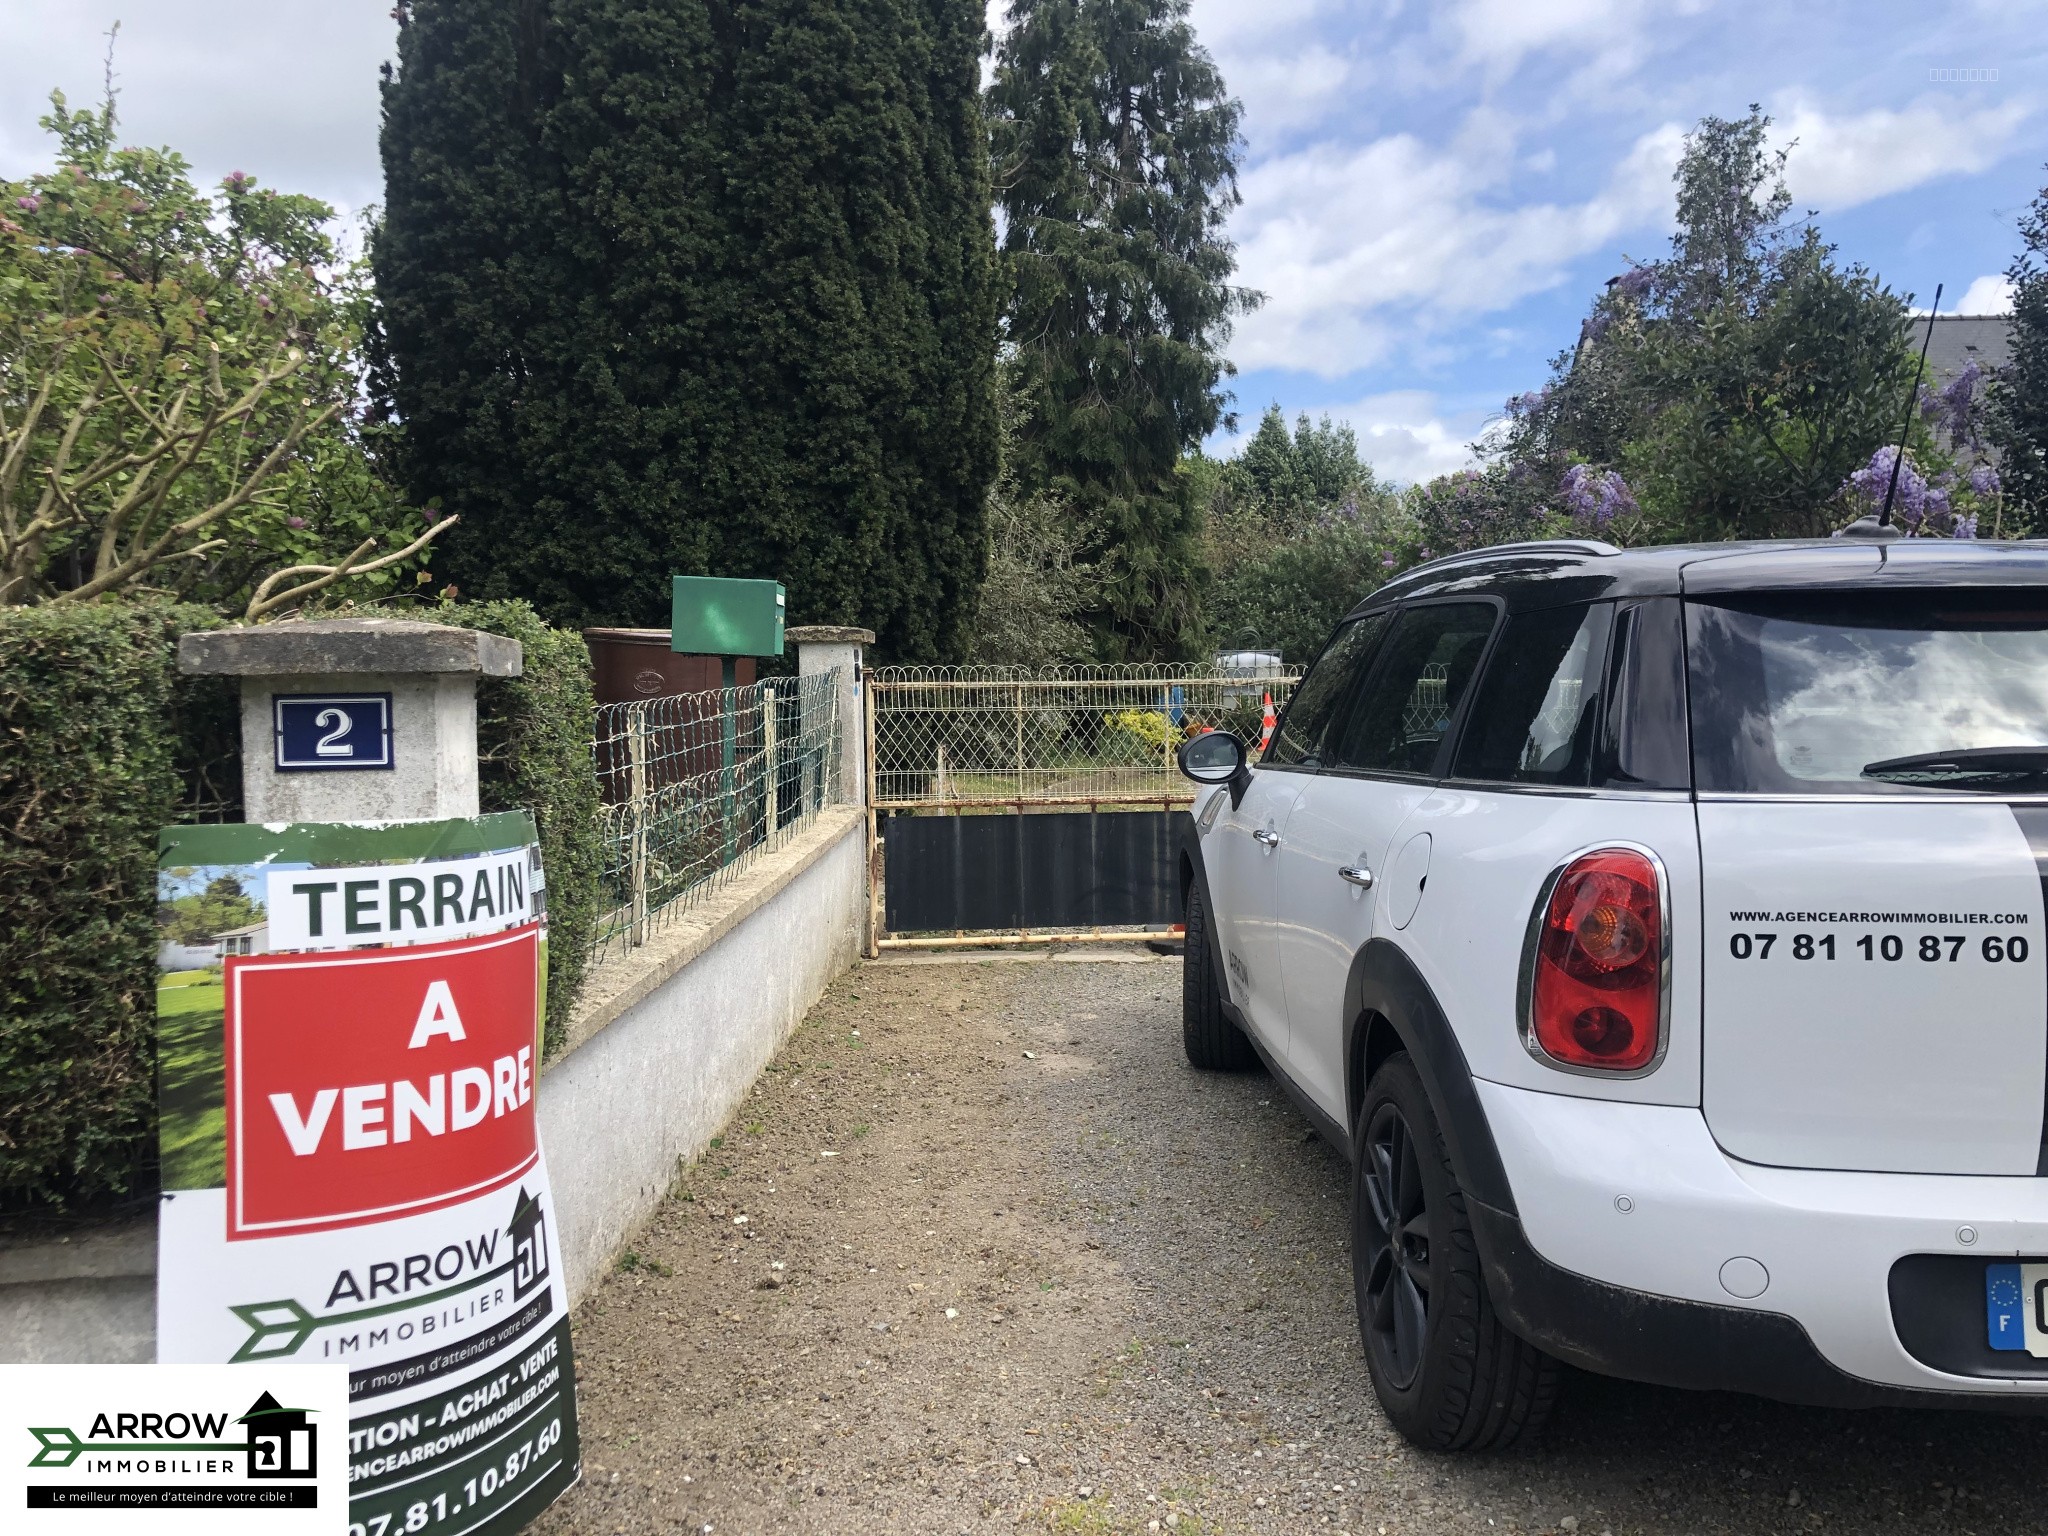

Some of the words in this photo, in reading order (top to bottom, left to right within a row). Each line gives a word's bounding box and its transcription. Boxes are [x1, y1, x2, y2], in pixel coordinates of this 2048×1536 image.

[315, 708, 353, 757] 2
[292, 861, 525, 938] TERRAIN
[1729, 911, 2029, 924] WWW.AGENCEARROWIMMOBILIER.COM
[1729, 933, 1778, 960] 07
[1792, 934, 1836, 961] 81
[1856, 934, 1904, 961] 10
[1918, 935, 1967, 962] 87
[1981, 936, 2029, 963] 60
[407, 979, 467, 1049] A
[268, 1045, 532, 1157] VENDRE
[324, 1228, 499, 1309] ARROW
[323, 1288, 504, 1357] IMMOBILIER
[371, 1363, 424, 1389] moyen
[498, 1322, 521, 1342] votre
[521, 1308, 539, 1327] cible
[1999, 1314, 2011, 1332] F
[438, 1373, 512, 1428] ACHAT
[518, 1336, 558, 1382] VENTE
